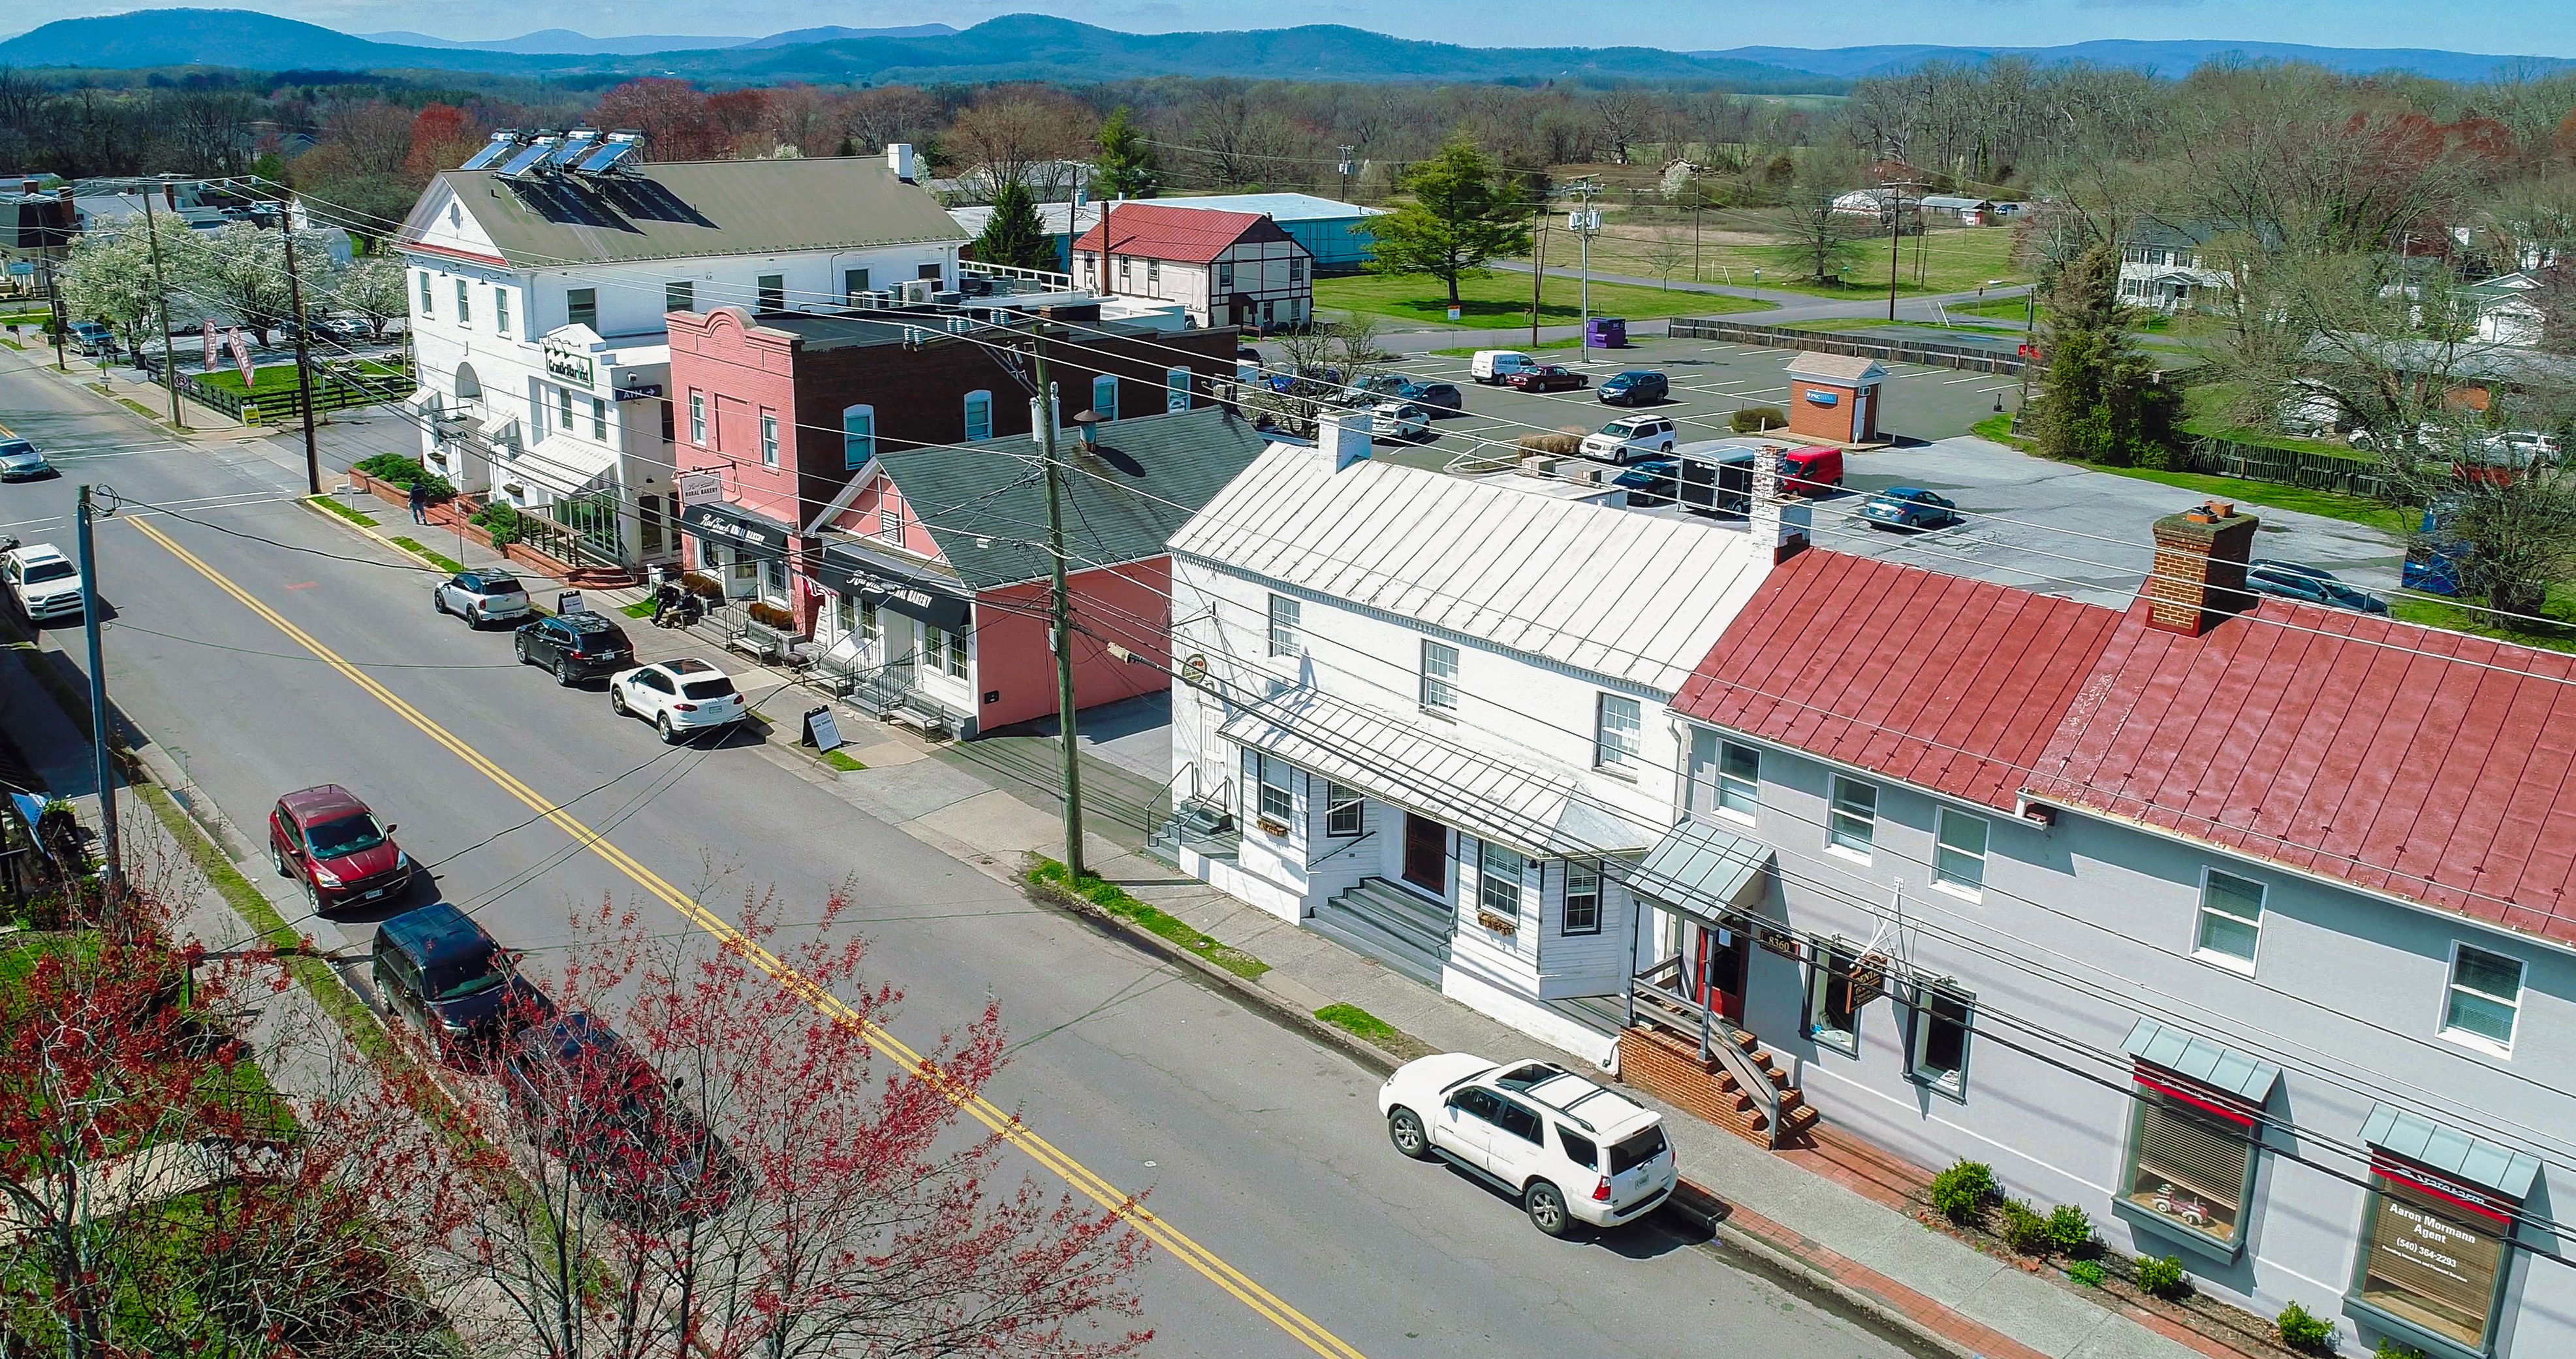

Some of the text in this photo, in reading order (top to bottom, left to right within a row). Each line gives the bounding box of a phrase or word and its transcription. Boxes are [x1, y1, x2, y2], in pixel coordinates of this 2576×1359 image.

[623, 389, 642, 399] ATM
[700, 513, 715, 526] Red
[907, 590, 933, 609] BAKERY
[1769, 936, 1789, 951] 8360
[2389, 1203, 2475, 1244] Aaron Mormann
[2413, 1224, 2447, 1244] Agent
[2396, 1237, 2457, 1268] (540) 364-2293
